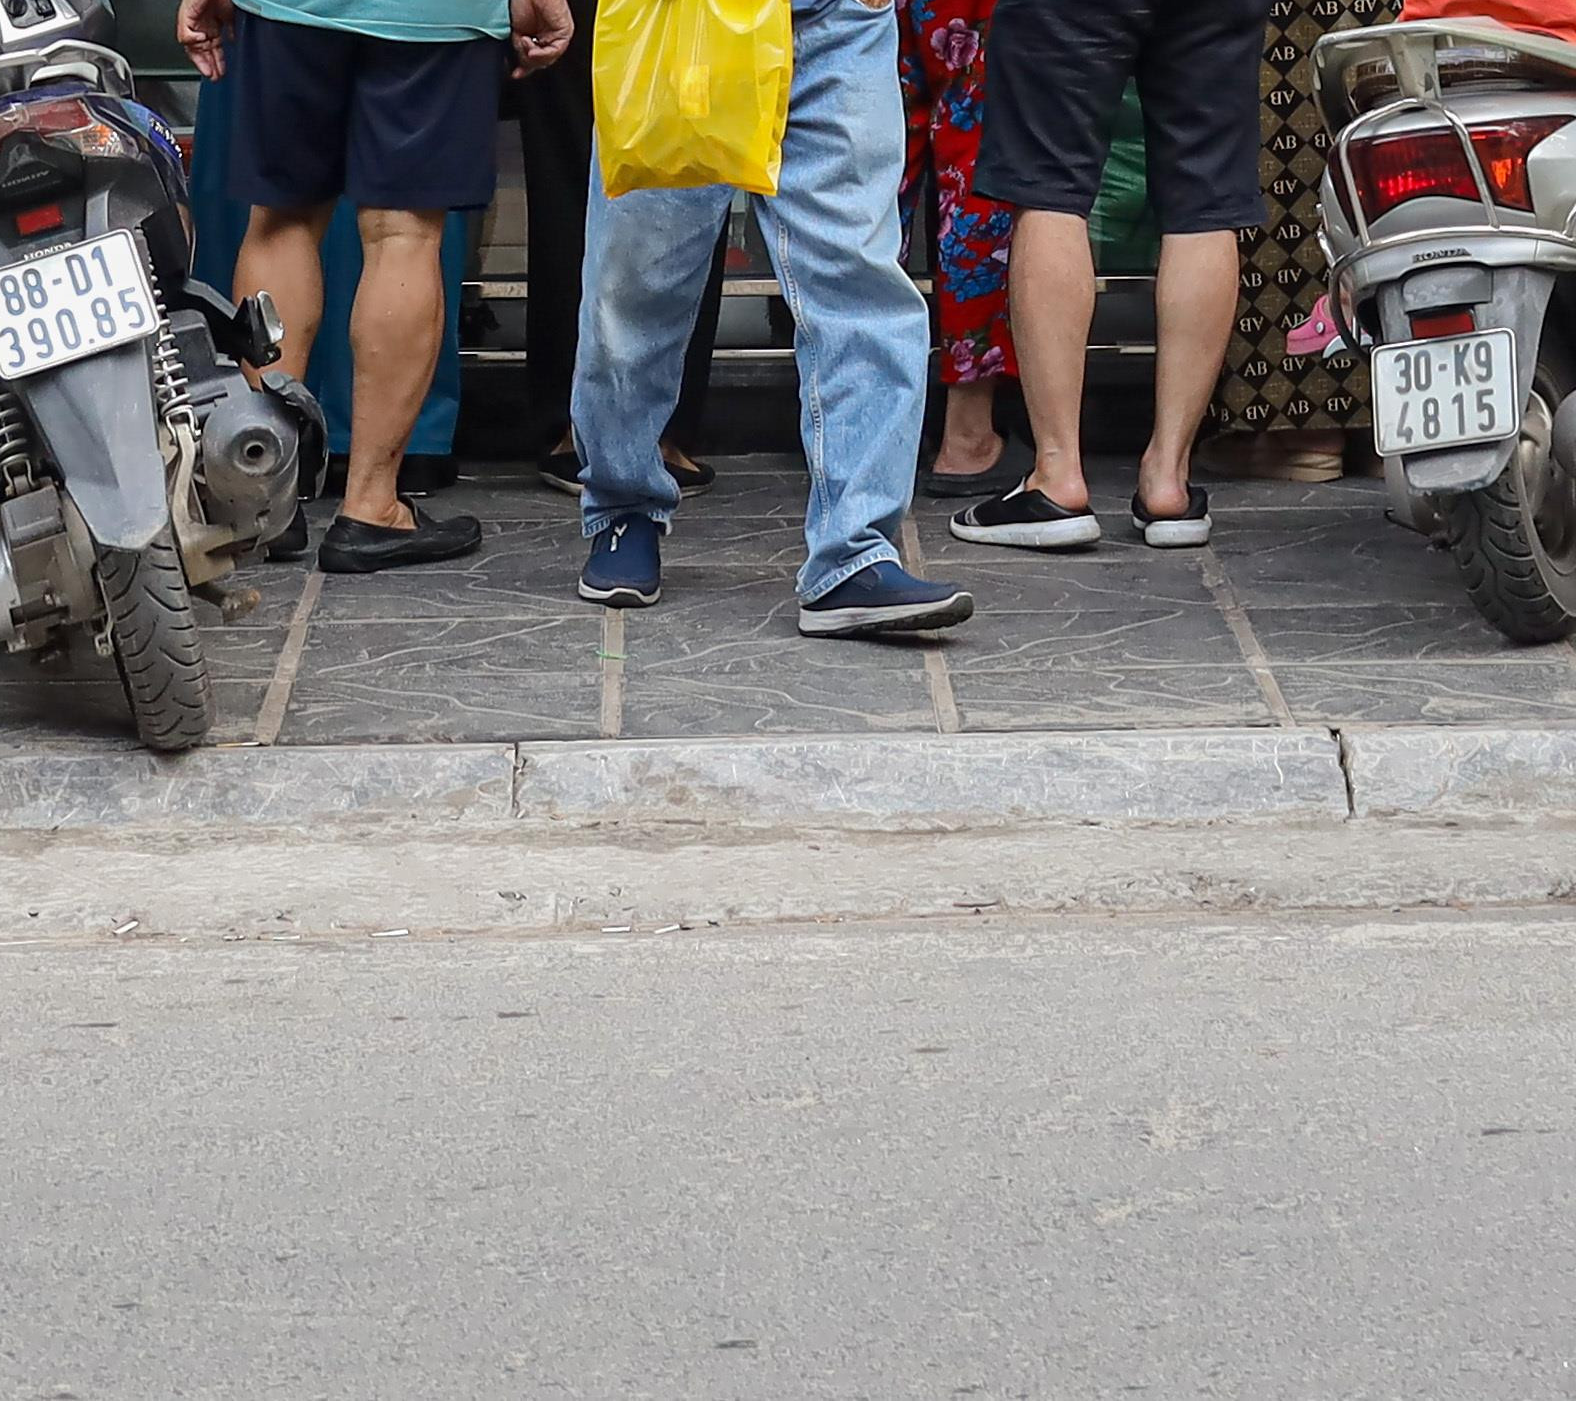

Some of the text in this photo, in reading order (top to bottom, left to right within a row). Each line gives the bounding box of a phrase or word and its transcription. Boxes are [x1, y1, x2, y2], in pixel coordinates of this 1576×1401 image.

[1269, 46, 1296, 61] AB
[1276, 224, 1302, 240] AB
[0, 244, 114, 316] 88-D1
[1243, 361, 1269, 378] AB
[1393, 340, 1495, 396] 30-K9
[1395, 388, 1497, 445] 4815
